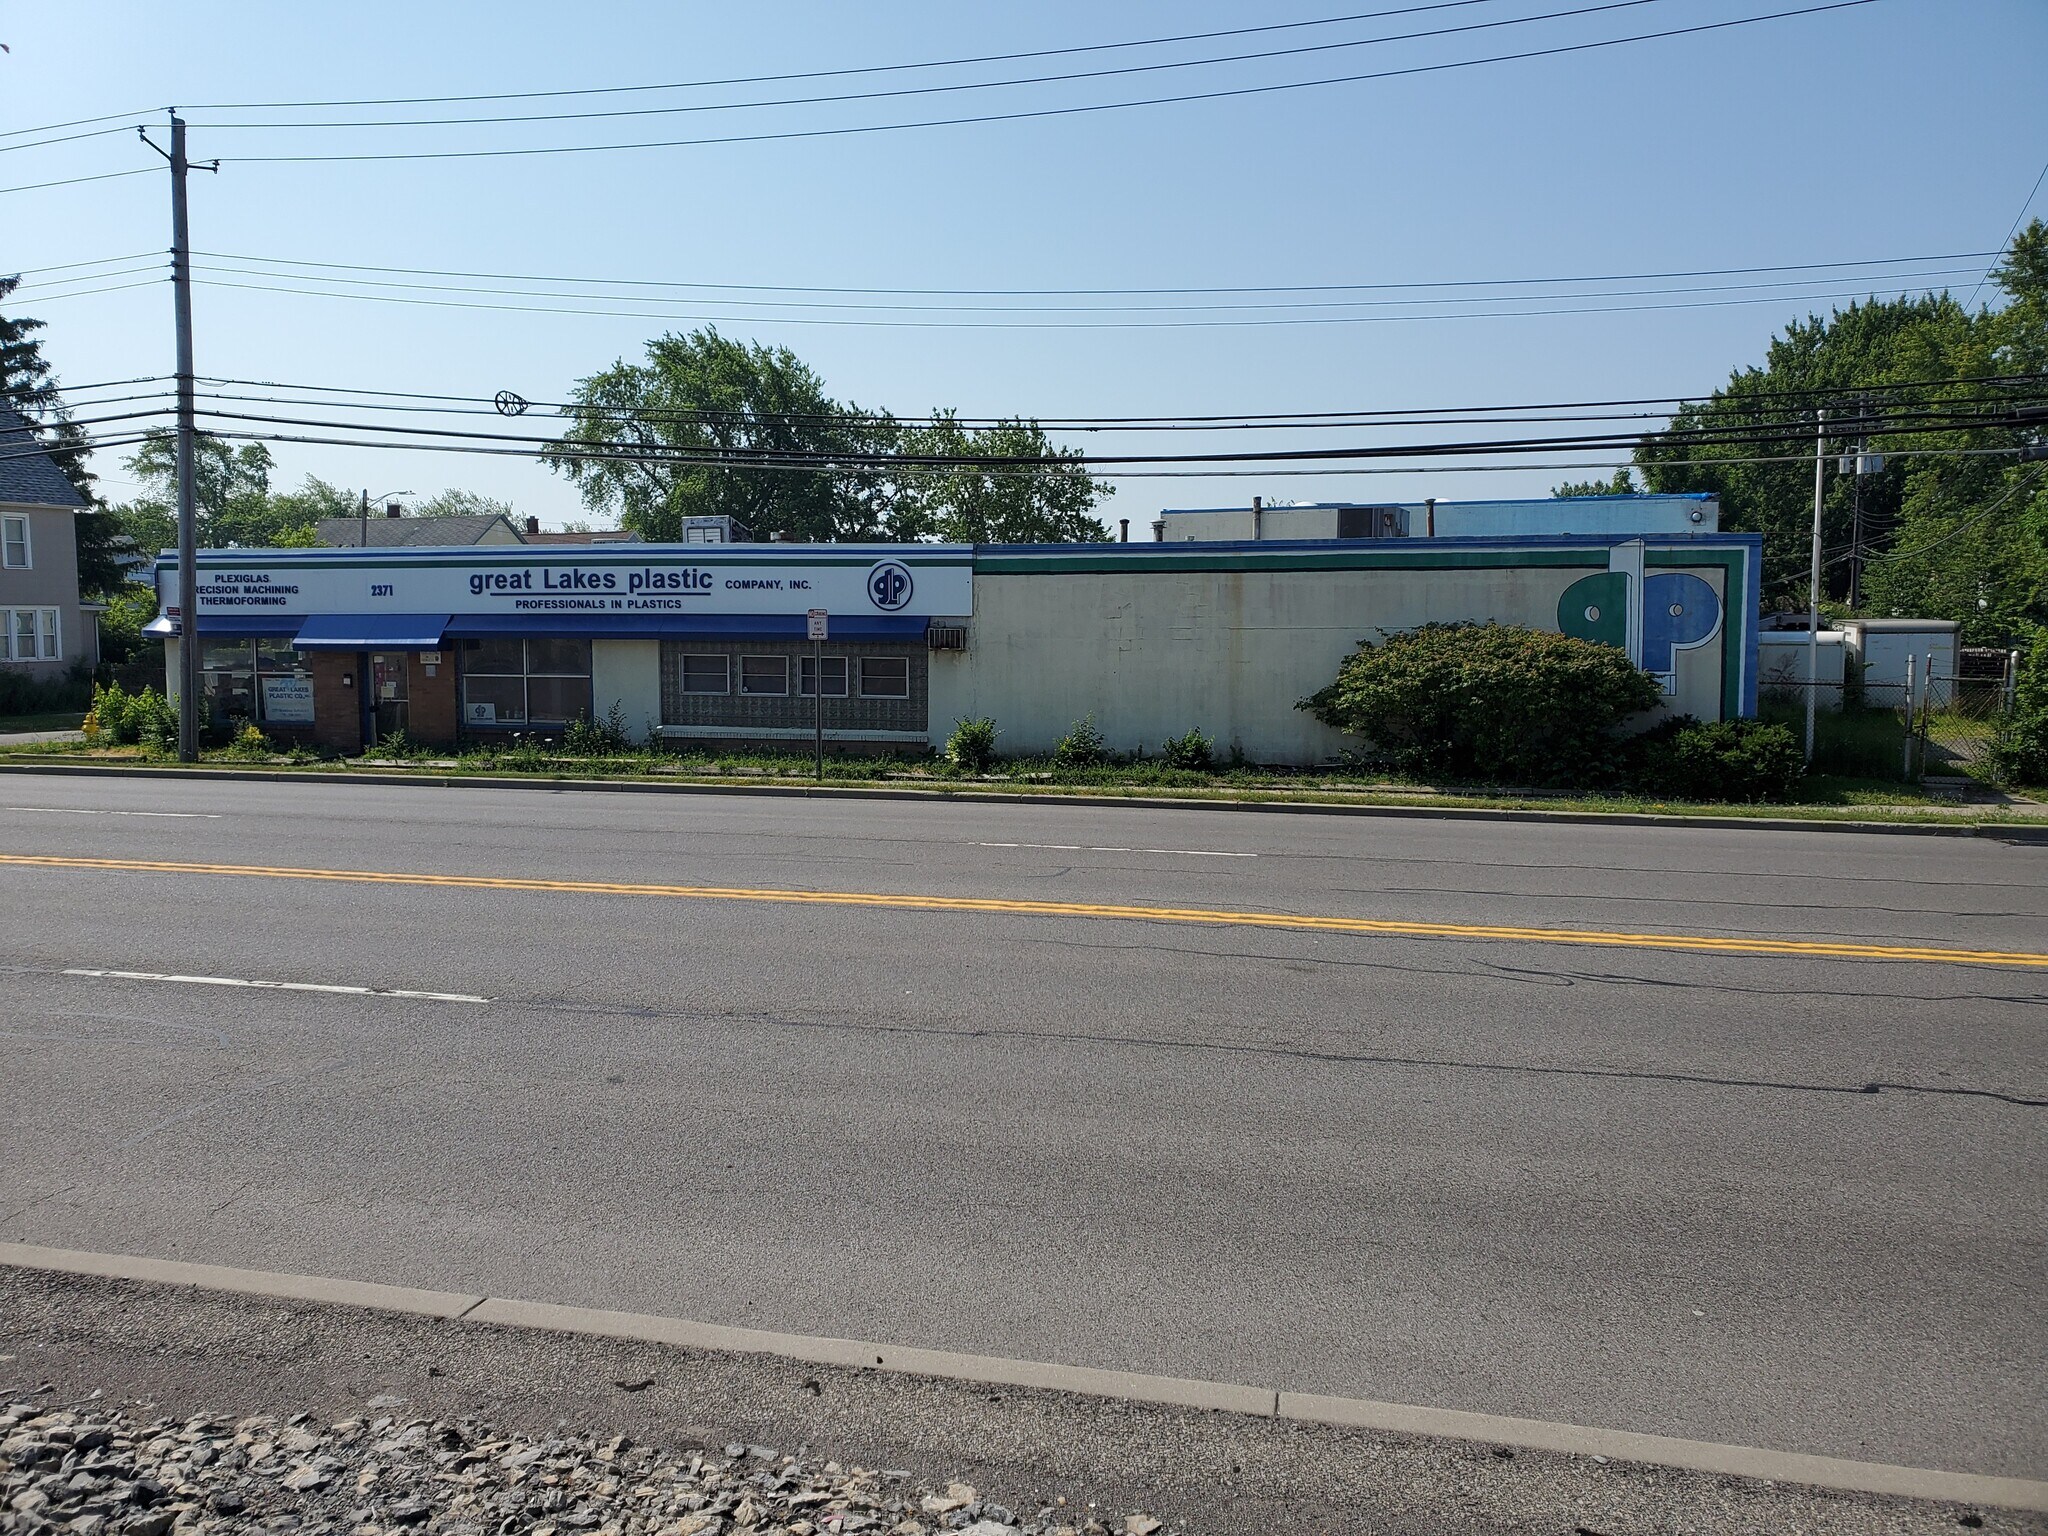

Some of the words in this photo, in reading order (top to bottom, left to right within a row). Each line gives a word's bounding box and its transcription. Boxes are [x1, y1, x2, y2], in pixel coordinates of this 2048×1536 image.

[214, 574, 270, 583] PLEXIGLAS
[469, 569, 532, 595] great
[543, 568, 616, 589] Lakes
[628, 568, 713, 593] plastic
[725, 580, 783, 591] COMPANY,
[789, 580, 812, 589] INC.
[195, 585, 239, 594] RECISION
[243, 585, 299, 594] MACHINING
[370, 584, 393, 596] 2371
[200, 596, 287, 605] THERMOFORMING
[515, 599, 606, 609] PROFESSIONALS
[610, 599, 623, 609] IN
[627, 599, 682, 609] PLASTICS
